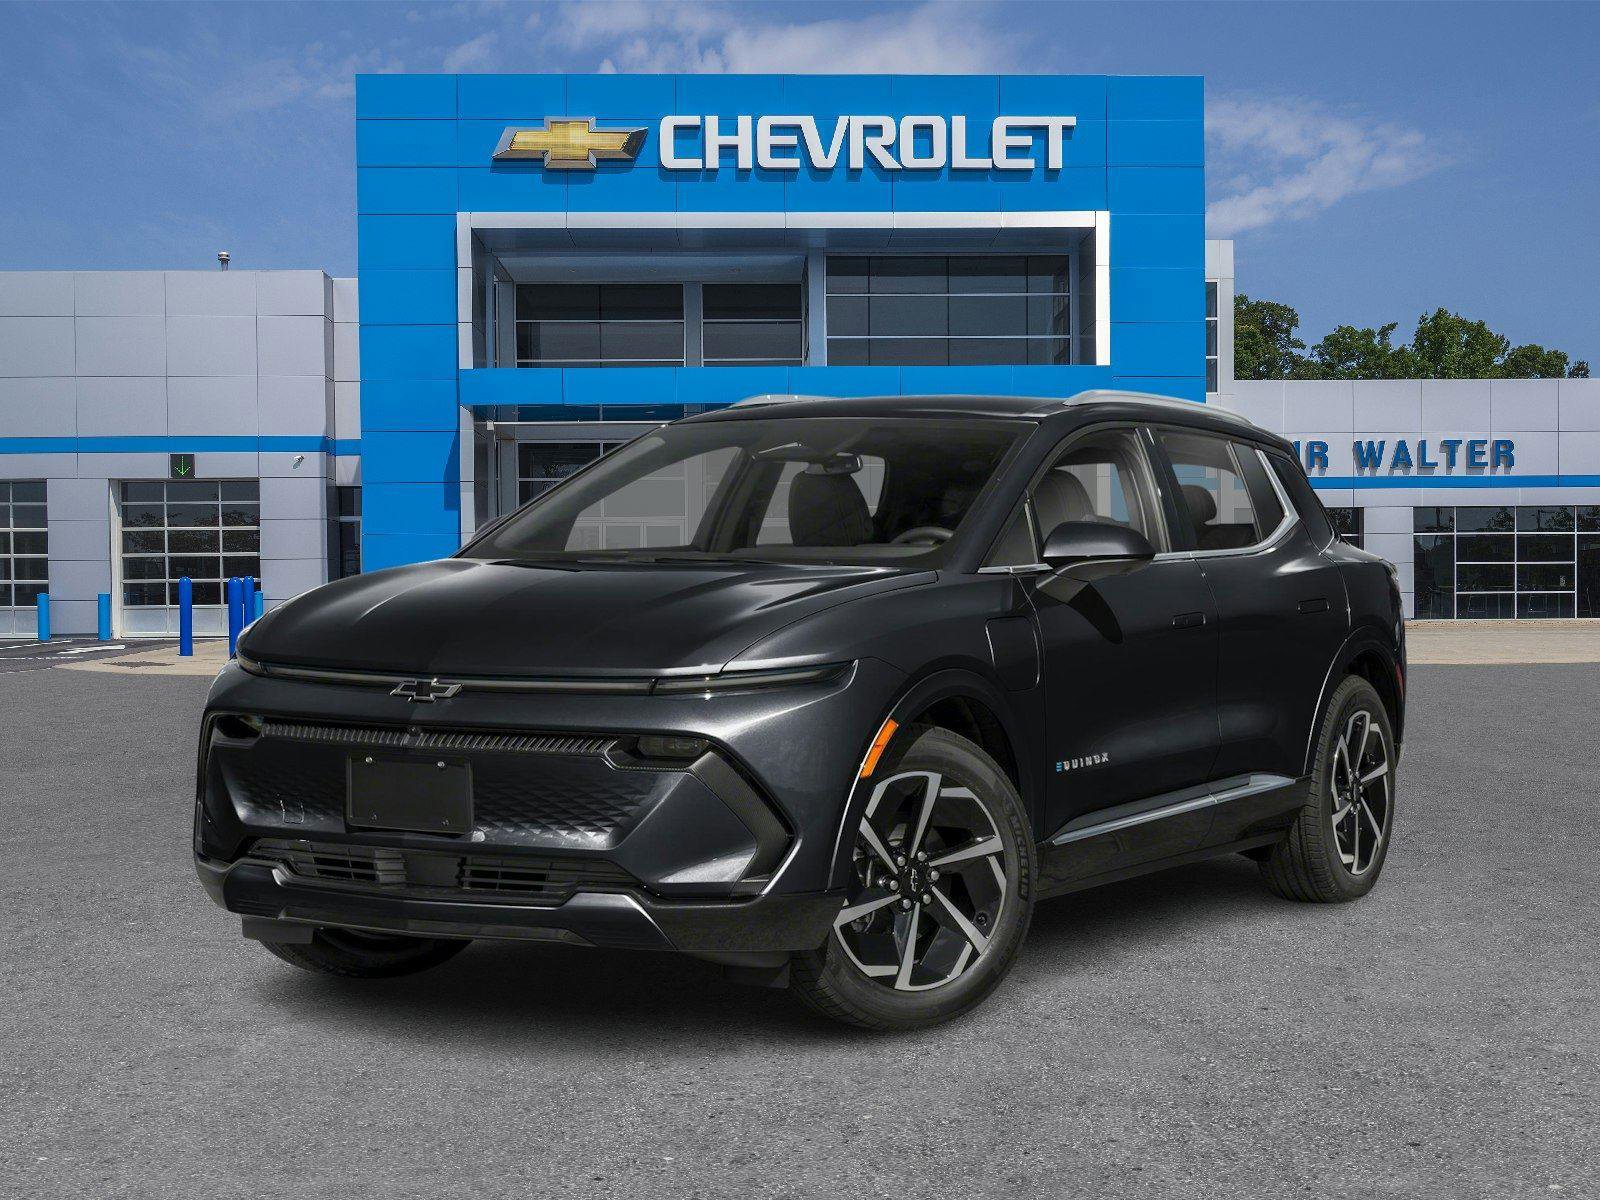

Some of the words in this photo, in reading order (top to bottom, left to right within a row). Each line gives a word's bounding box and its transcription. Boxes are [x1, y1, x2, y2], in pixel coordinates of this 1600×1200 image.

[659, 115, 1077, 170] CHEVROLET
[1352, 439, 1516, 469] WALTER
[1055, 752, 1109, 773] EQUINOX
